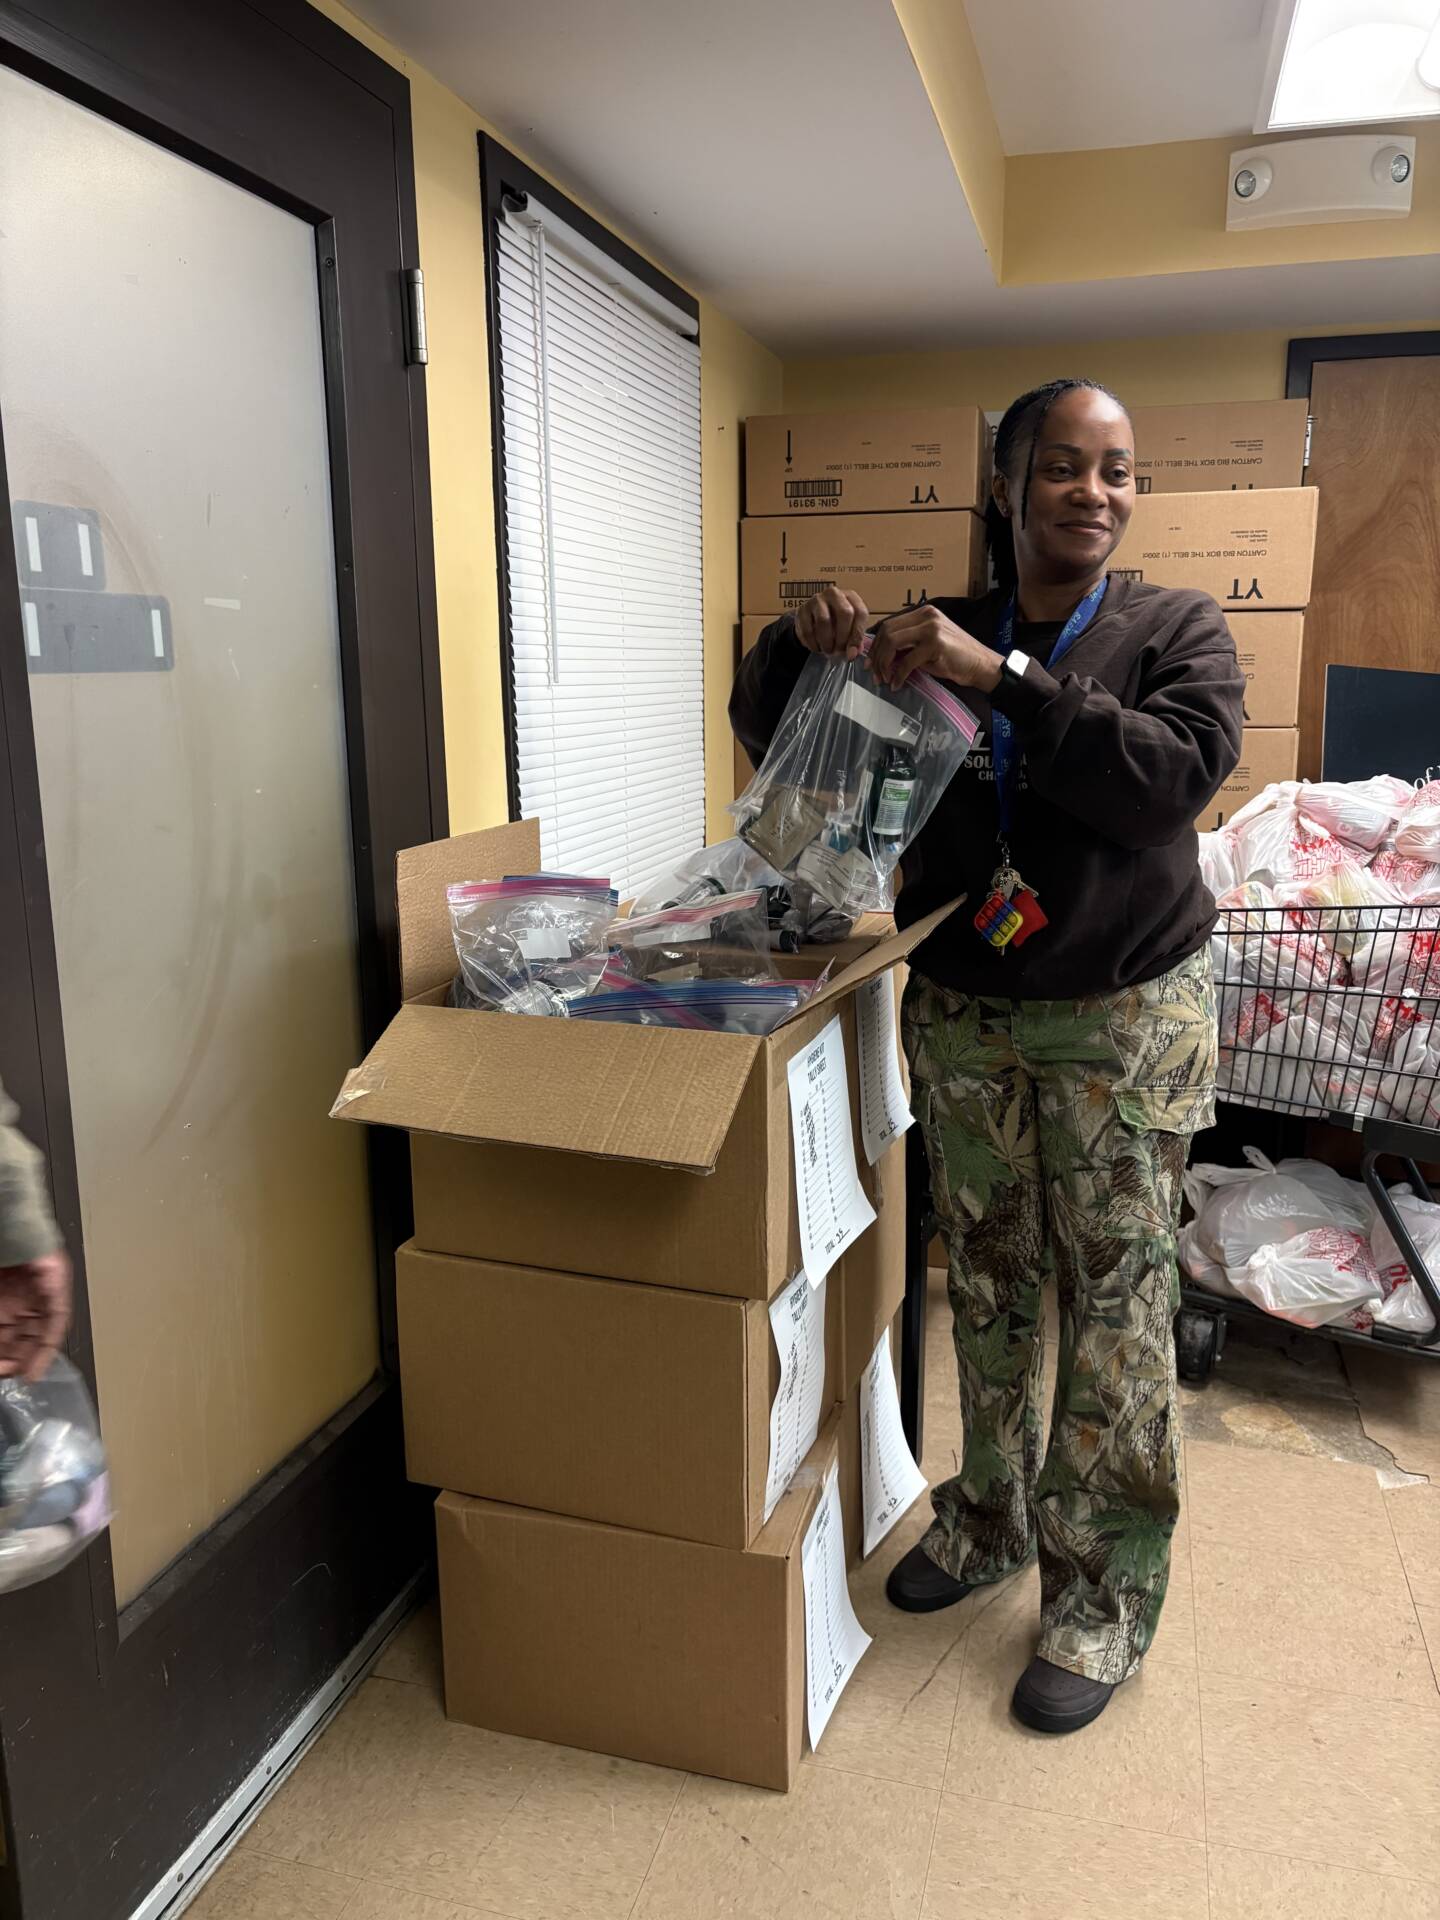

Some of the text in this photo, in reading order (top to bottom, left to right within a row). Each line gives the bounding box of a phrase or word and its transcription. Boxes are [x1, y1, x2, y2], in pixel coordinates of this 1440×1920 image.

[913, 460, 941, 468] CARTON
[1183, 459, 1198, 467] THE
[1231, 457, 1262, 465] CARTON
[910, 484, 939, 504] YT
[788, 498, 839, 508] GIN: 93191
[1162, 551, 1171, 559] (1)
[1235, 549, 1267, 557] CARTON
[847, 566, 863, 574] BELL
[864, 566, 876, 574] THE
[878, 565, 892, 573] BOX
[893, 565, 905, 573] BIG
[906, 564, 933, 573] CARTON
[1227, 579, 1263, 599] YT
[902, 589, 928, 606] YT
[783, 599, 807, 608] 3191
